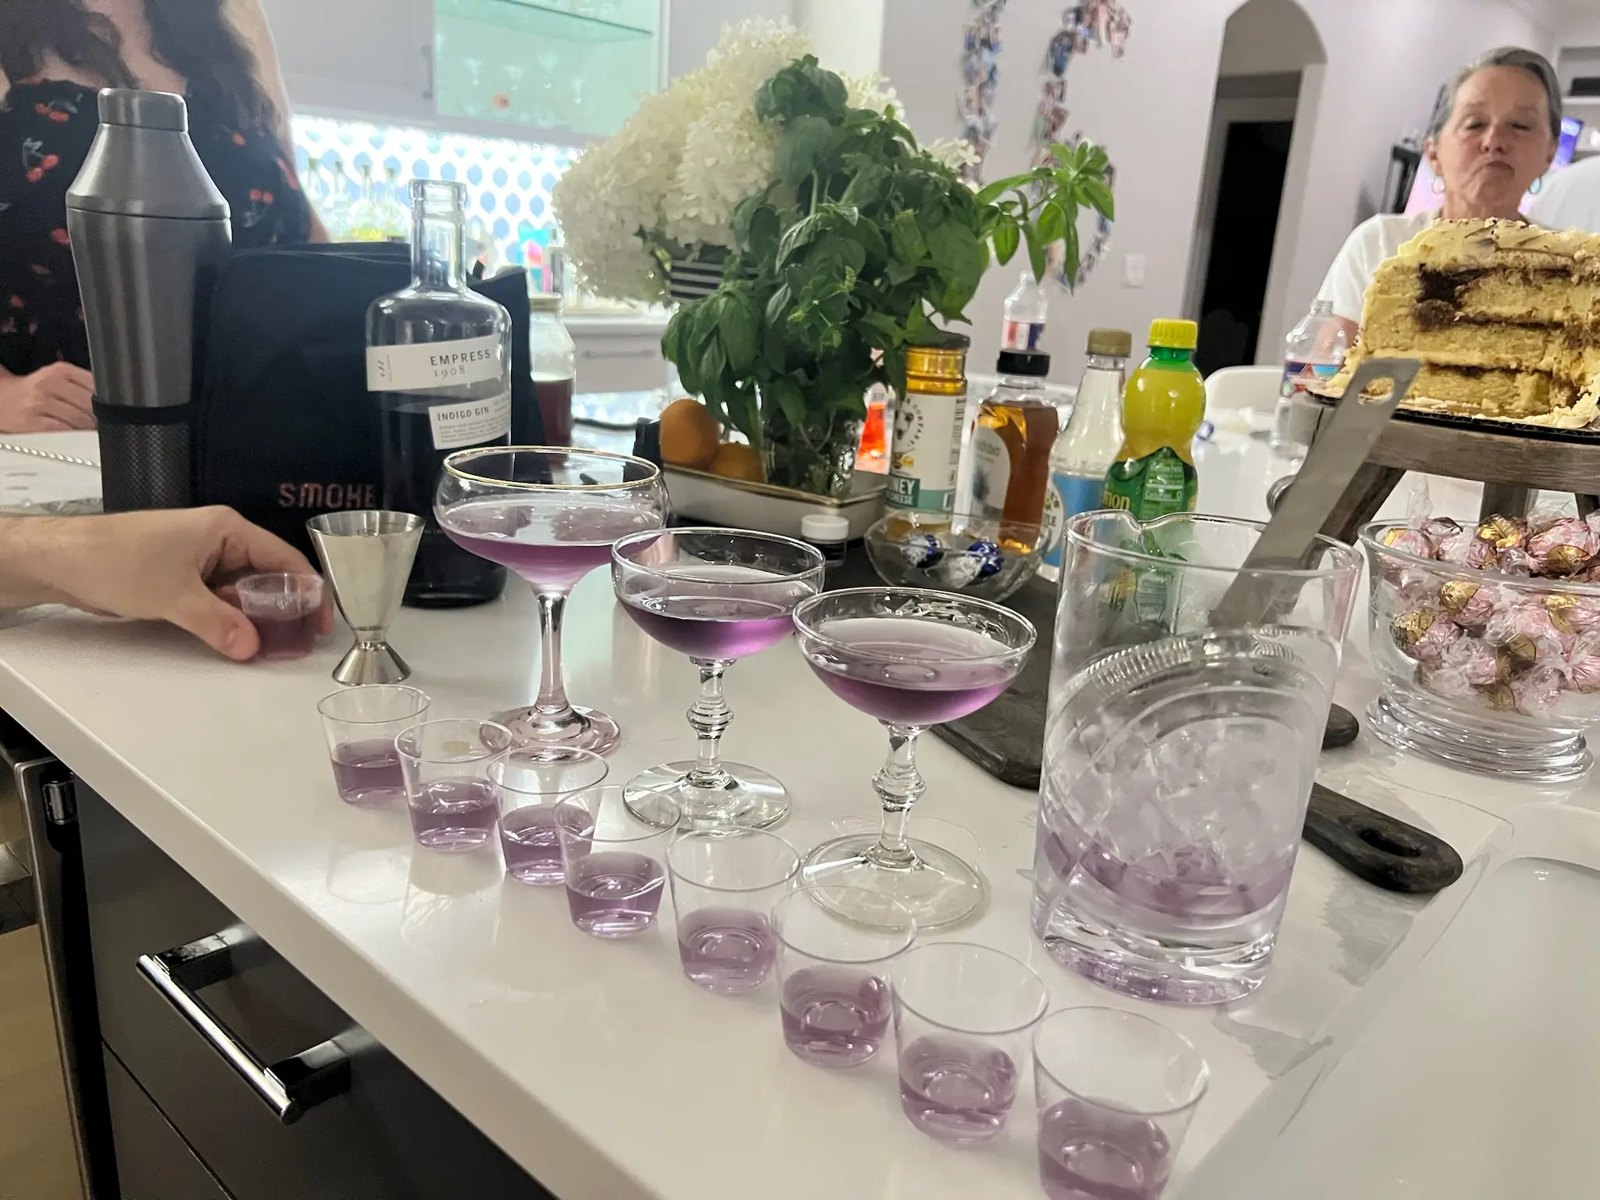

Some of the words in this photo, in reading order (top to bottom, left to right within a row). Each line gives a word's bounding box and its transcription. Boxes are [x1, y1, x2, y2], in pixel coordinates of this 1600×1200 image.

[430, 349, 491, 366] EMPRESS
[434, 364, 465, 380] 1908
[437, 409, 472, 421] INDIGO
[474, 406, 489, 416] GIN
